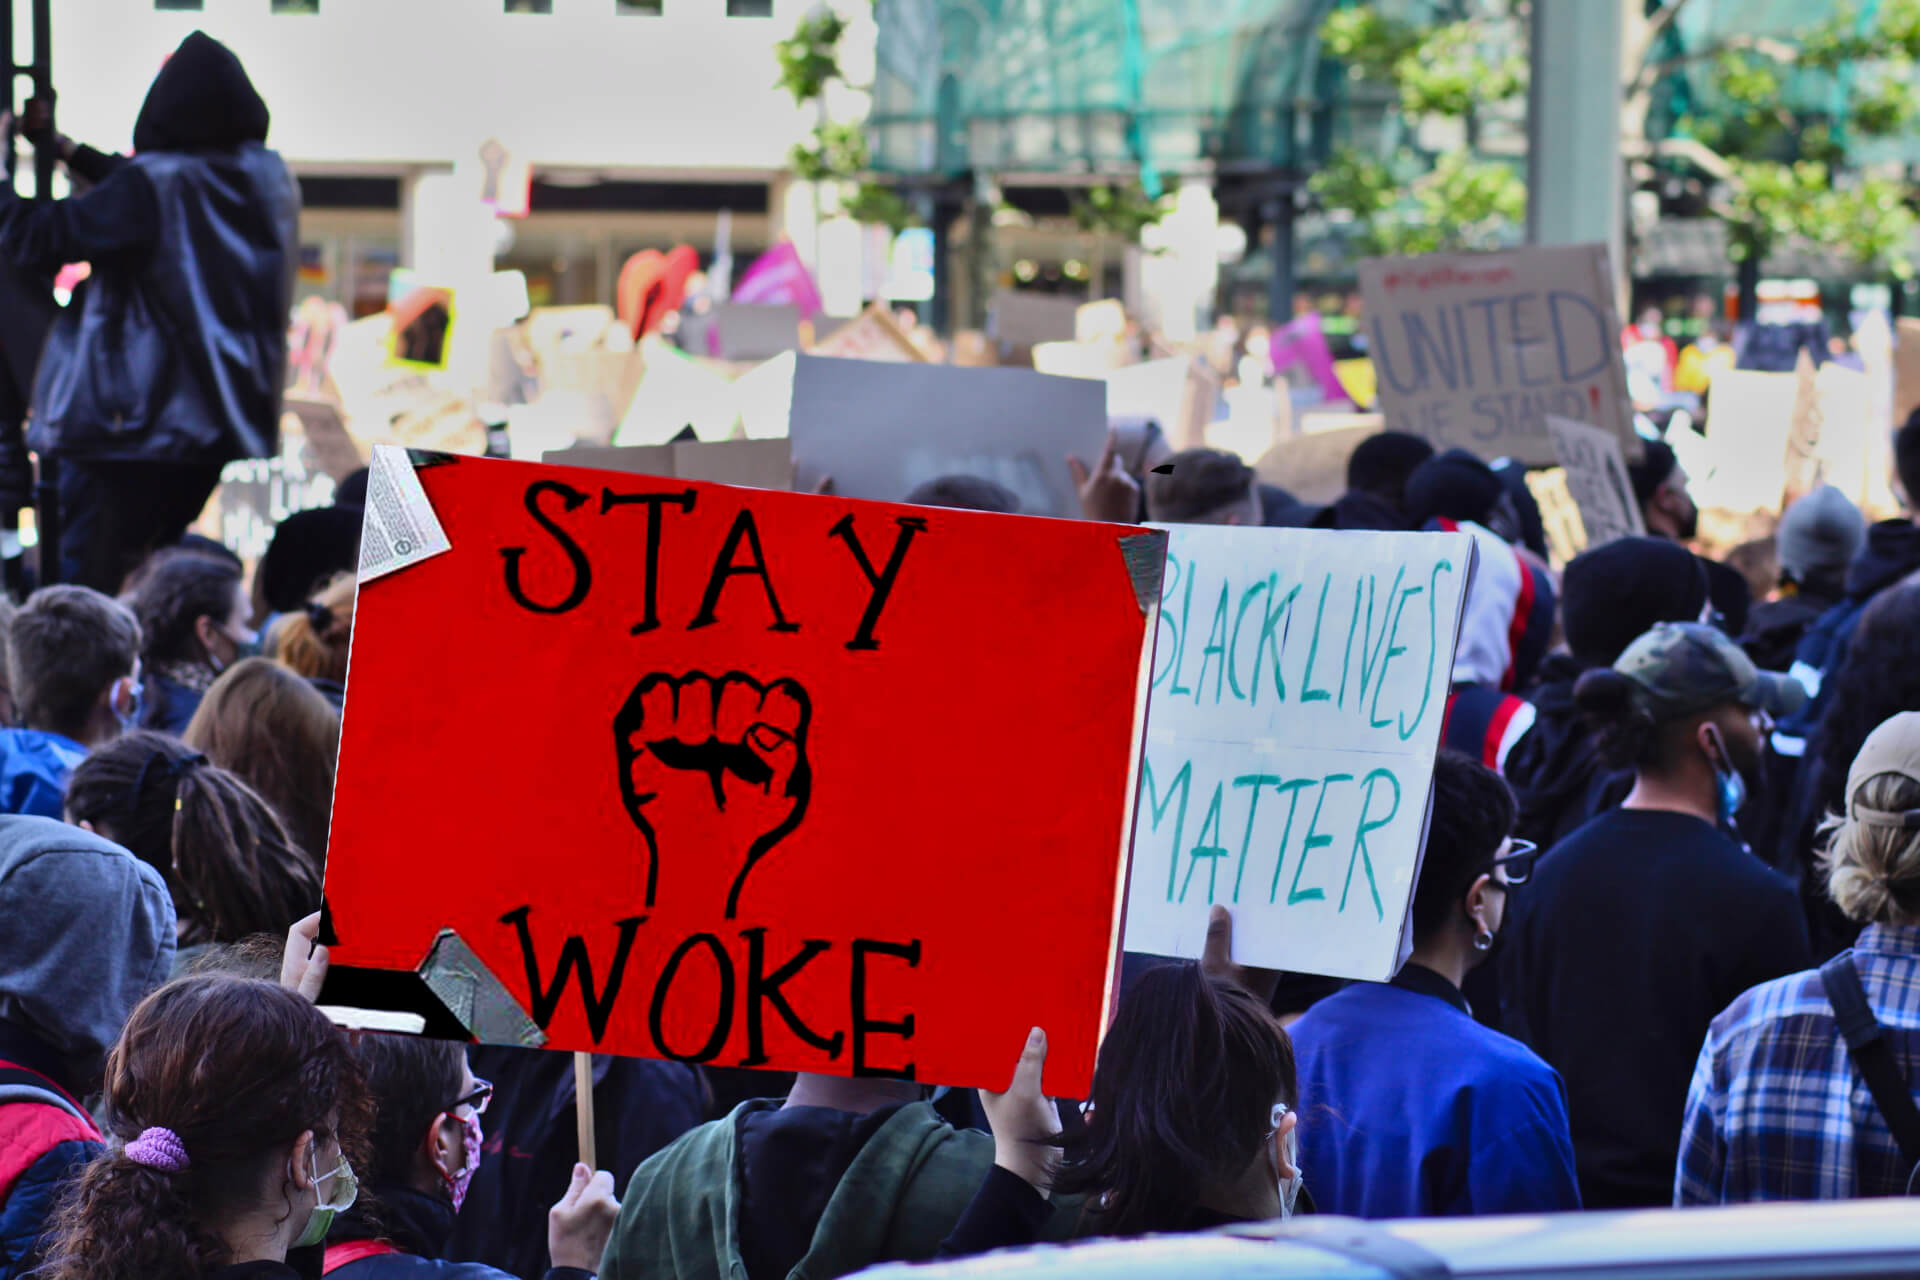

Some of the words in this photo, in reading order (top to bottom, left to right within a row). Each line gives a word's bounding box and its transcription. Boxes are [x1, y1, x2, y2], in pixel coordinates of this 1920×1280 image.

[1371, 290, 1611, 396] UNITED
[499, 480, 928, 650] STAY
[1152, 553, 1302, 706] BLACK
[1301, 558, 1452, 740] LIVES
[1141, 757, 1401, 924] MATTER
[498, 905, 921, 1081] WOKE
